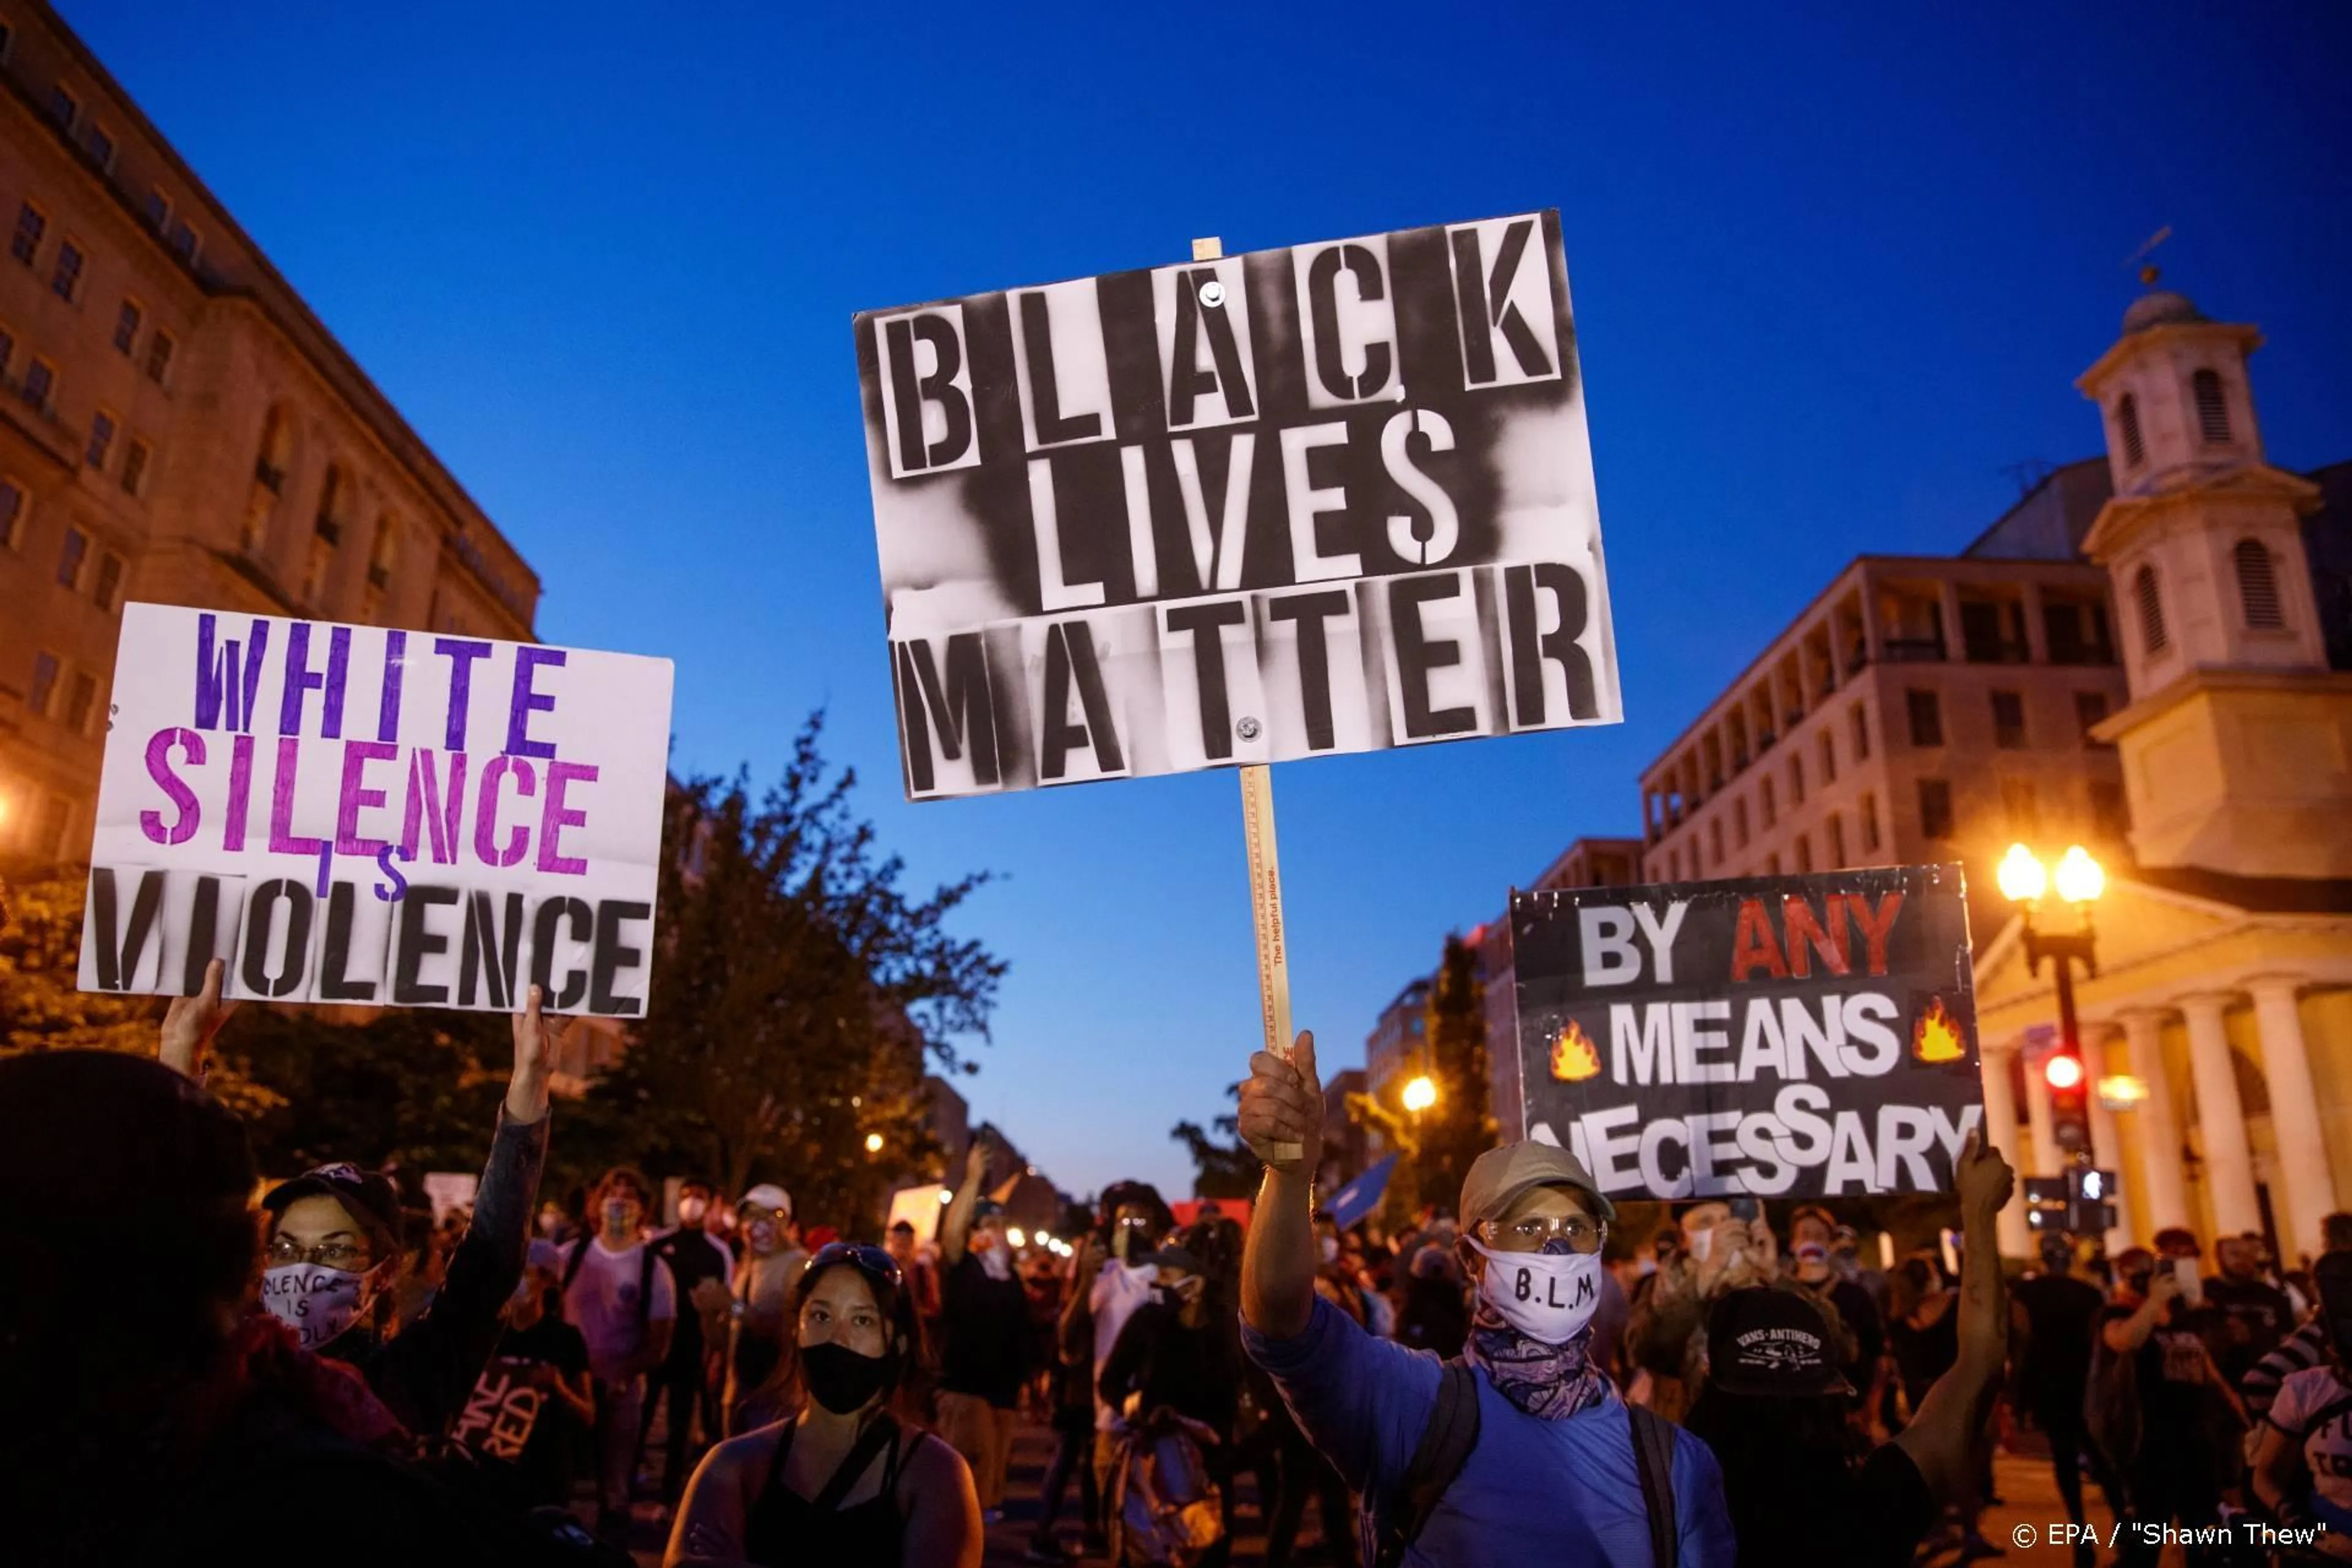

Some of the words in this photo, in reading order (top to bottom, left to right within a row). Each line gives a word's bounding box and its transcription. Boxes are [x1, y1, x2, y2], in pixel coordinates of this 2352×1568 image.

[885, 221, 1555, 471] BLACK
[1027, 408, 1460, 612] LIVES
[195, 613, 567, 758] WHITE
[896, 562, 1601, 792] MATTER
[140, 728, 598, 875] SILENCE
[317, 840, 411, 901] IS
[1270, 904, 1281, 941] helpful
[92, 868, 651, 1015] VIOLENCE
[1274, 945, 1283, 967] The
[1579, 900, 1692, 986] BY
[1731, 892, 1907, 982] ANY
[1610, 992, 1900, 1086] MEANS
[287, 1299, 309, 1317] IS
